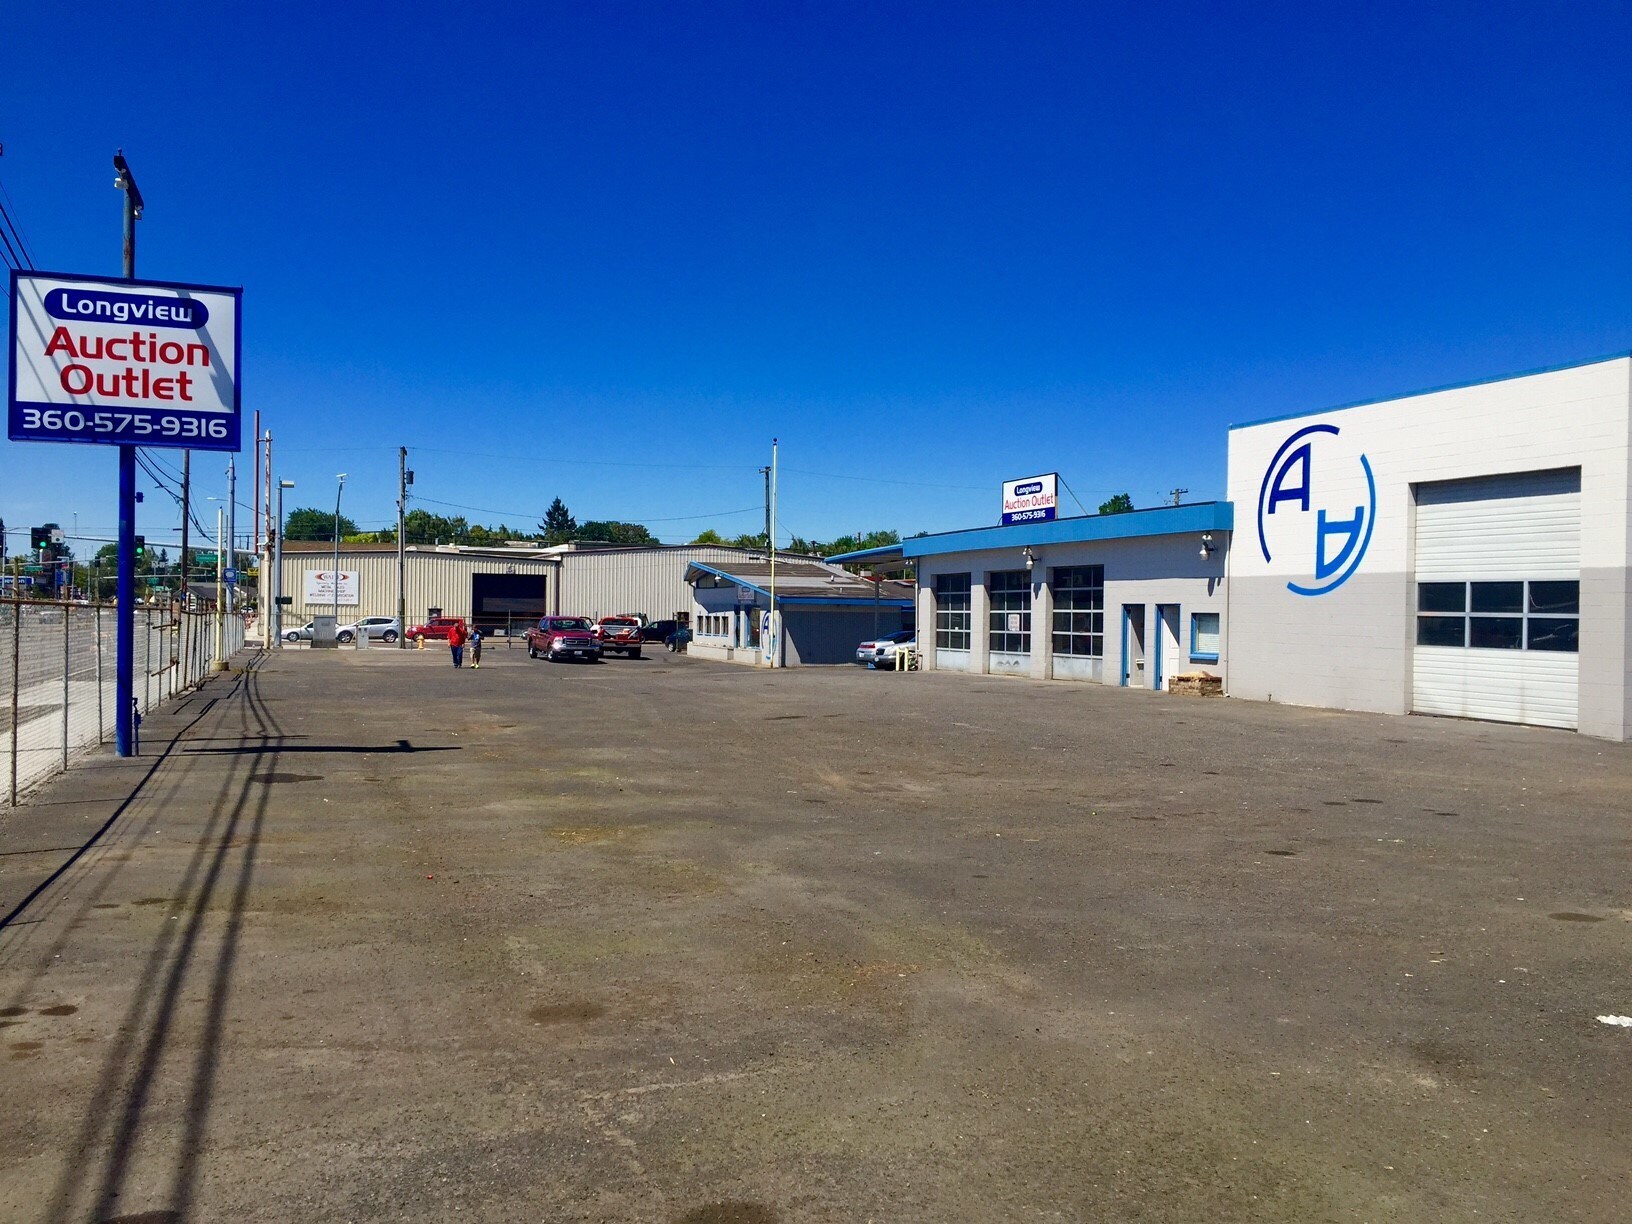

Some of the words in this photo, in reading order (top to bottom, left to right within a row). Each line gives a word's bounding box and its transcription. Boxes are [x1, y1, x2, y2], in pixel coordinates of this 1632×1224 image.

[61, 293, 193, 322] Longview
[44, 326, 210, 367] Auction
[60, 364, 193, 402] Outlet
[22, 408, 228, 438] 360-575-9316
[1005, 498, 1030, 510] Auction
[1031, 493, 1054, 506] Outlet
[1016, 485, 1040, 494] Longview
[1011, 510, 1045, 521] 360-575-9316
